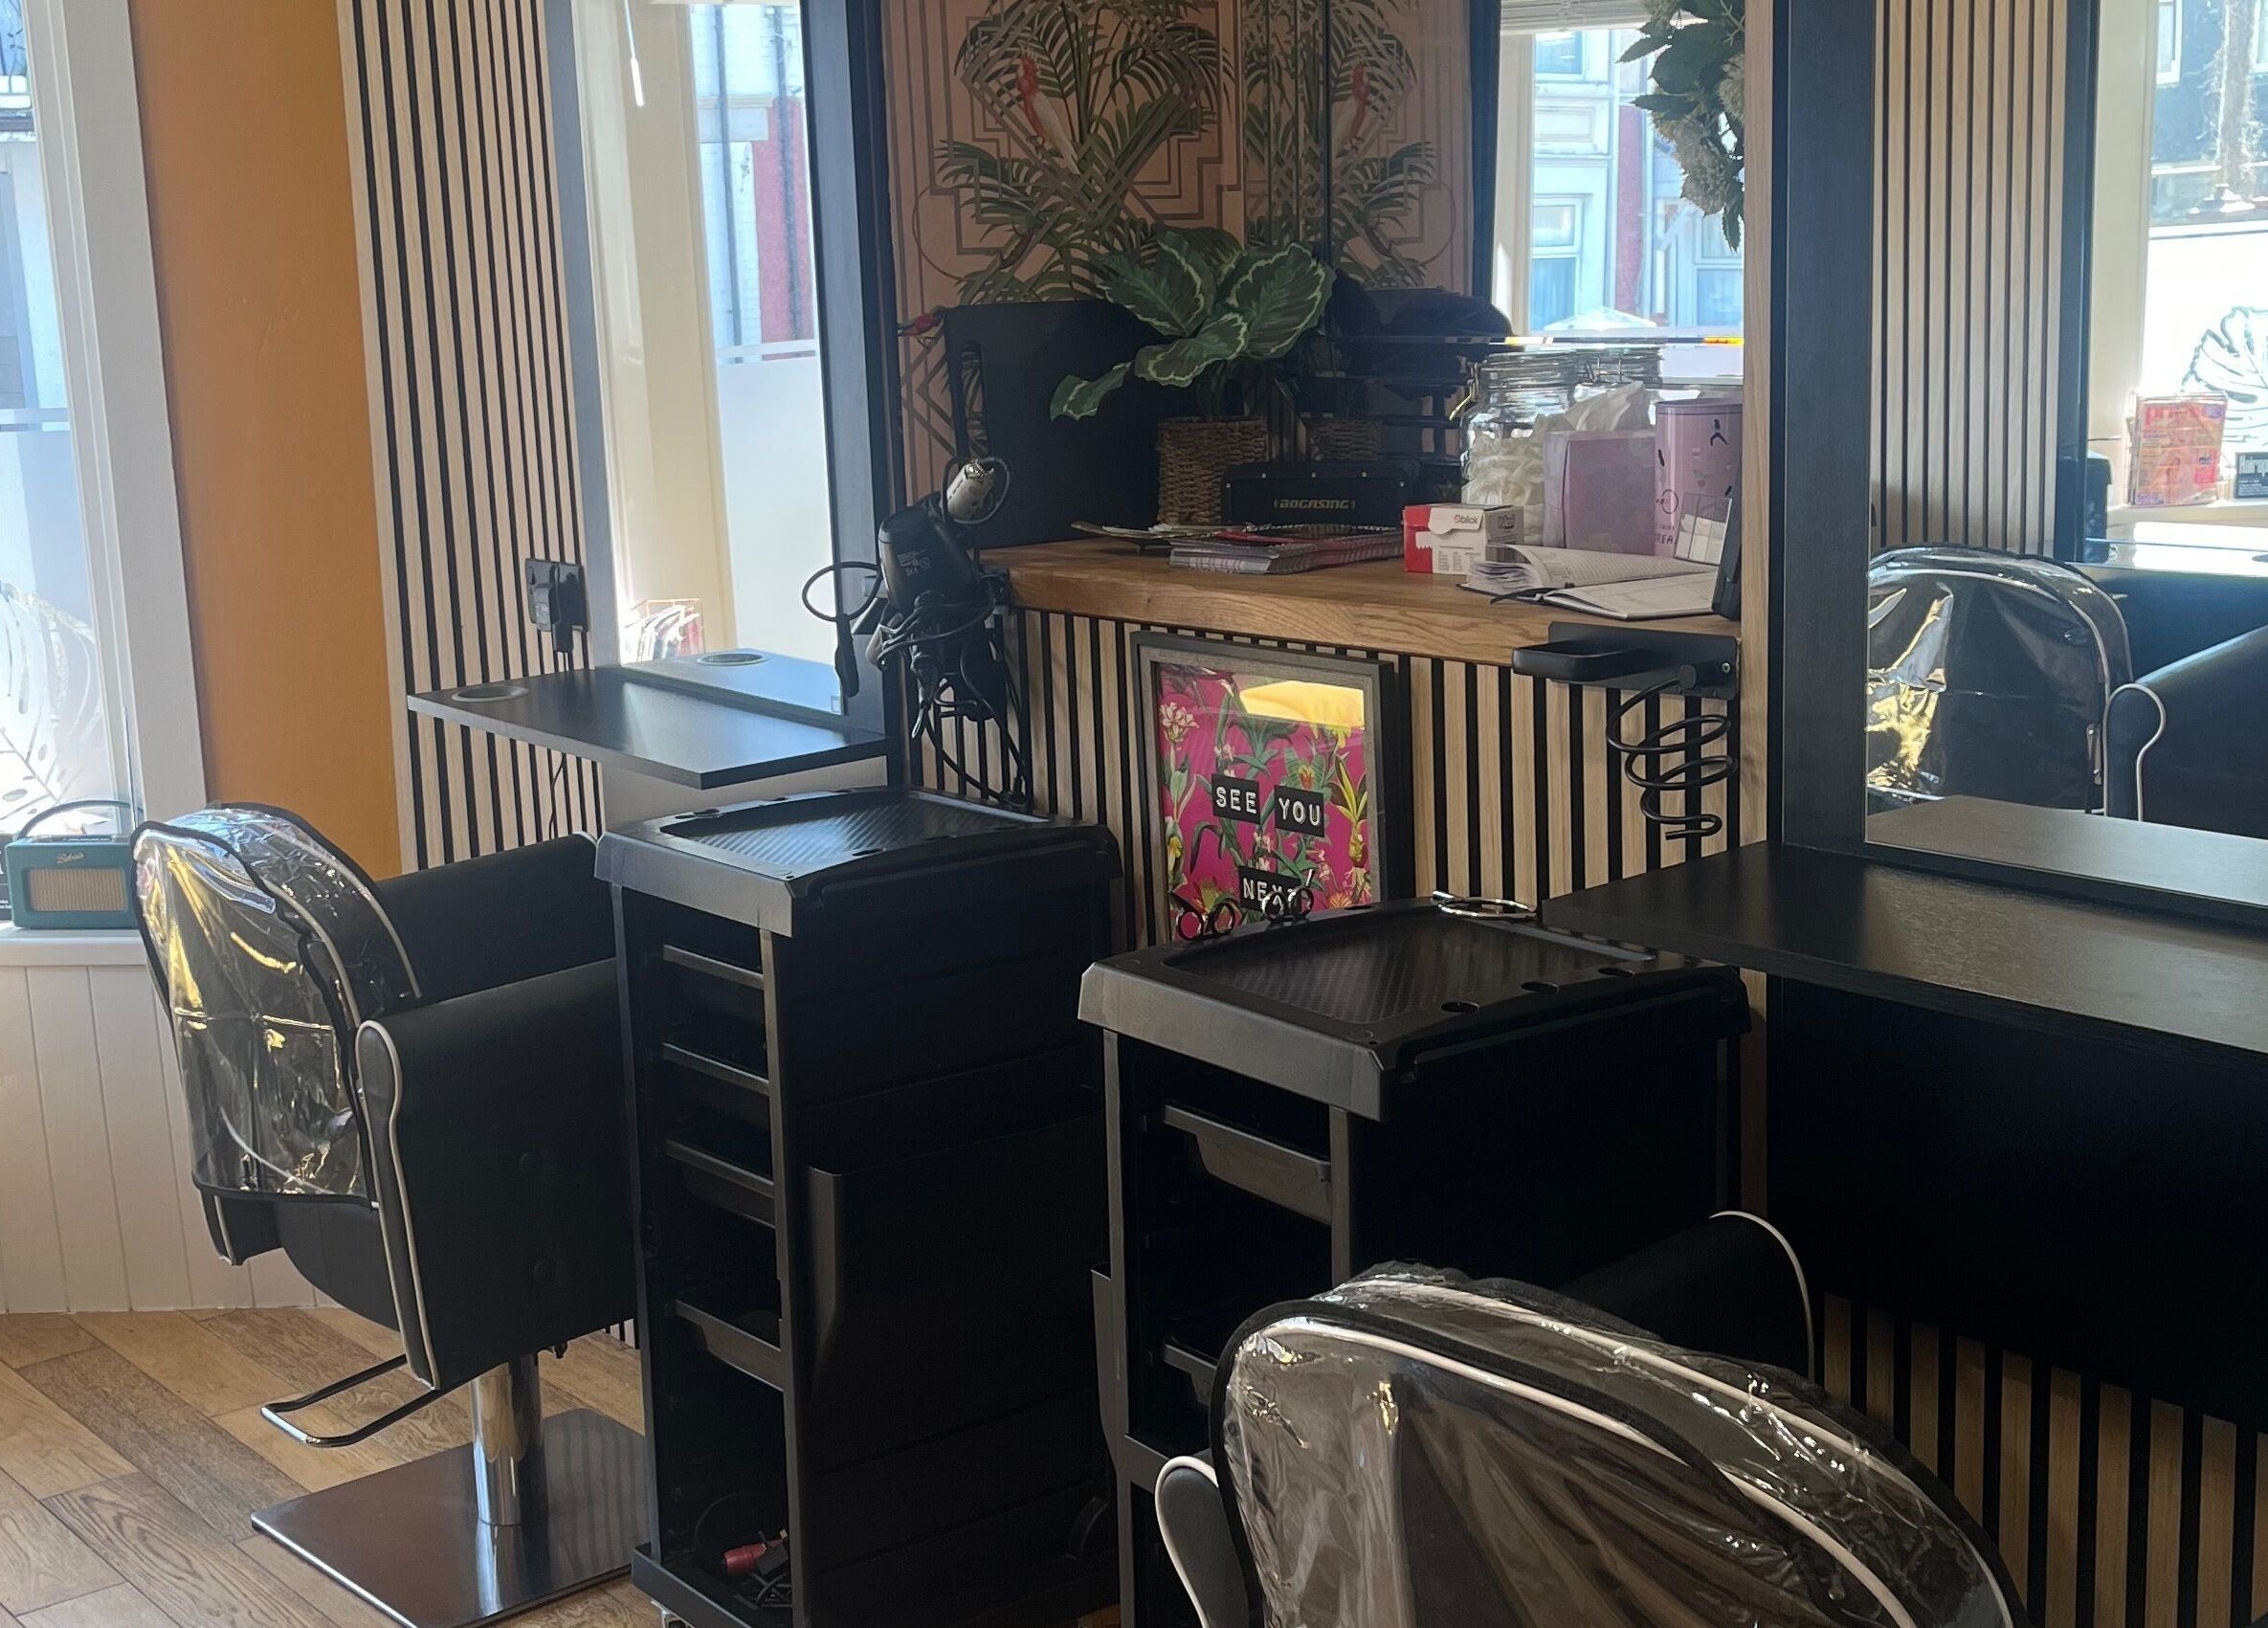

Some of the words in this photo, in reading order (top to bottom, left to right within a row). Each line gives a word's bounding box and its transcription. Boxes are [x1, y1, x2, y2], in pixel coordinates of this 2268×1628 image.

[1215, 786, 1257, 814] SEE
[1278, 796, 1322, 826] YOU
[1242, 877, 1297, 905] NEX
